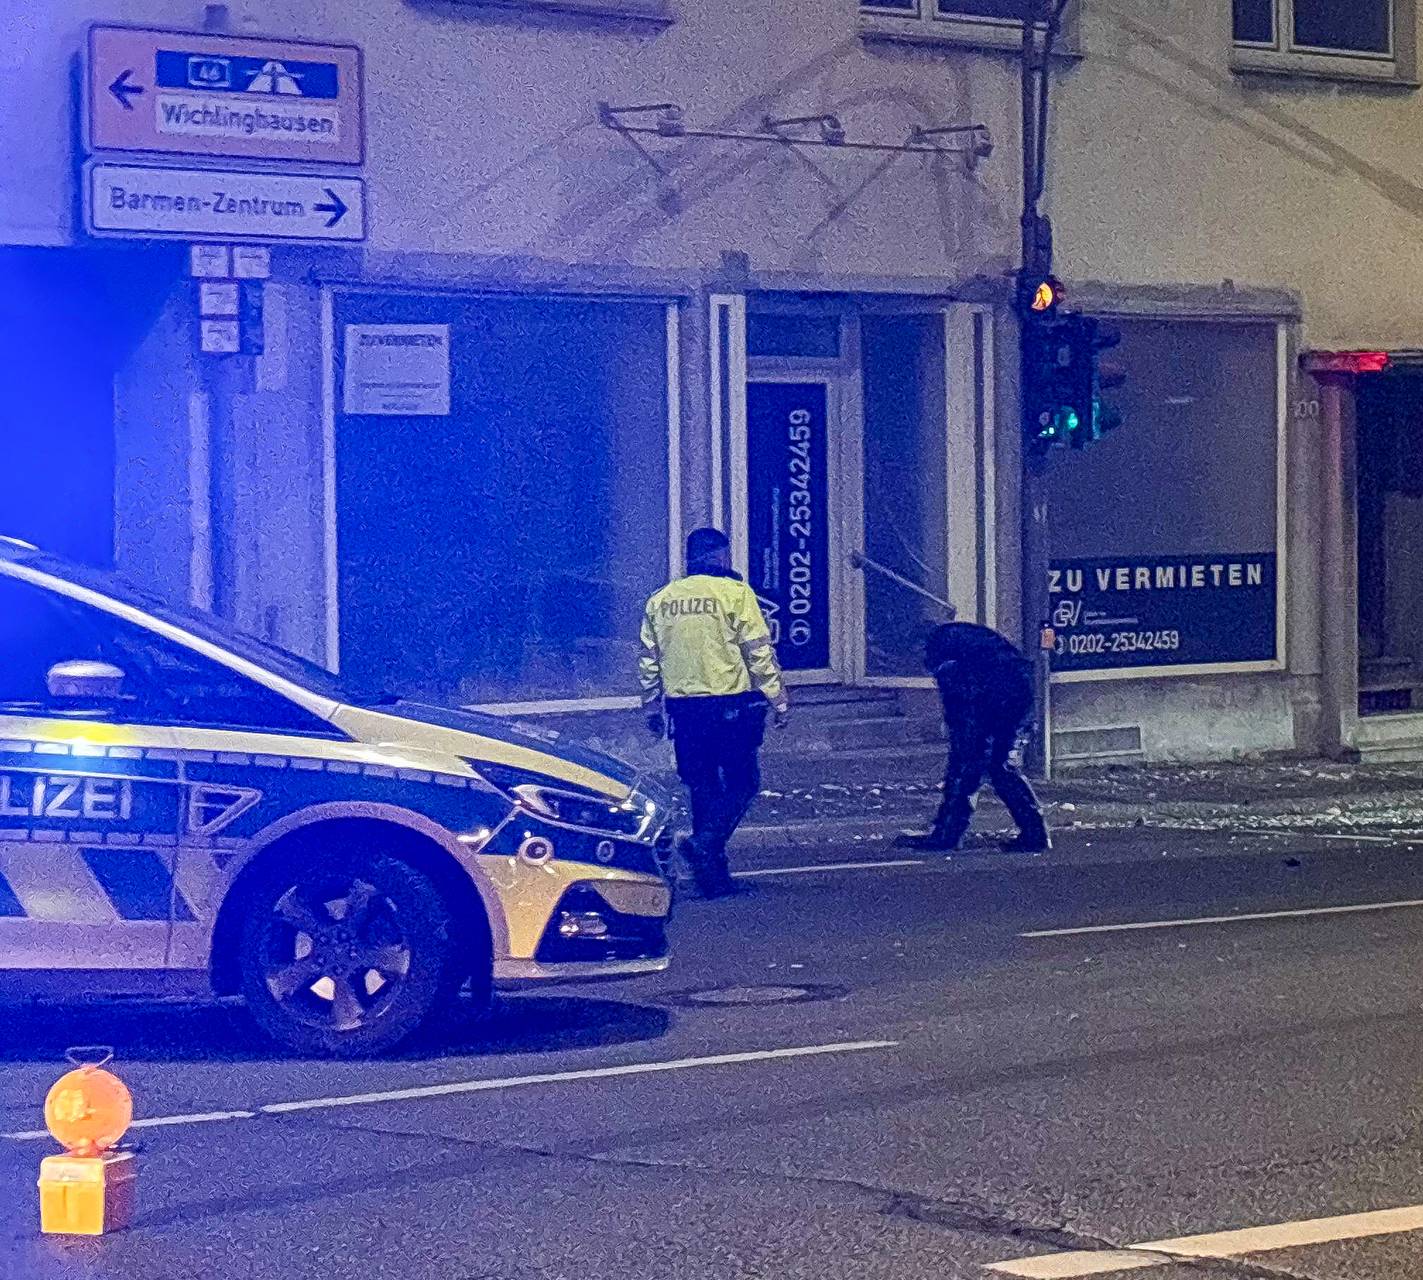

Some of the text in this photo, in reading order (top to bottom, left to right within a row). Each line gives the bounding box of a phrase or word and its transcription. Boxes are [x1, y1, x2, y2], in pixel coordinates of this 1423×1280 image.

[161, 102, 333, 133] Wichlinghausen
[110, 186, 305, 216] Barmen-Zentrum
[789, 409, 811, 615] 0202-25342459
[1049, 564, 1262, 592] ZU VERMIETEN
[661, 598, 717, 618] POLIZEI
[1069, 631, 1180, 654] 0202-25342459
